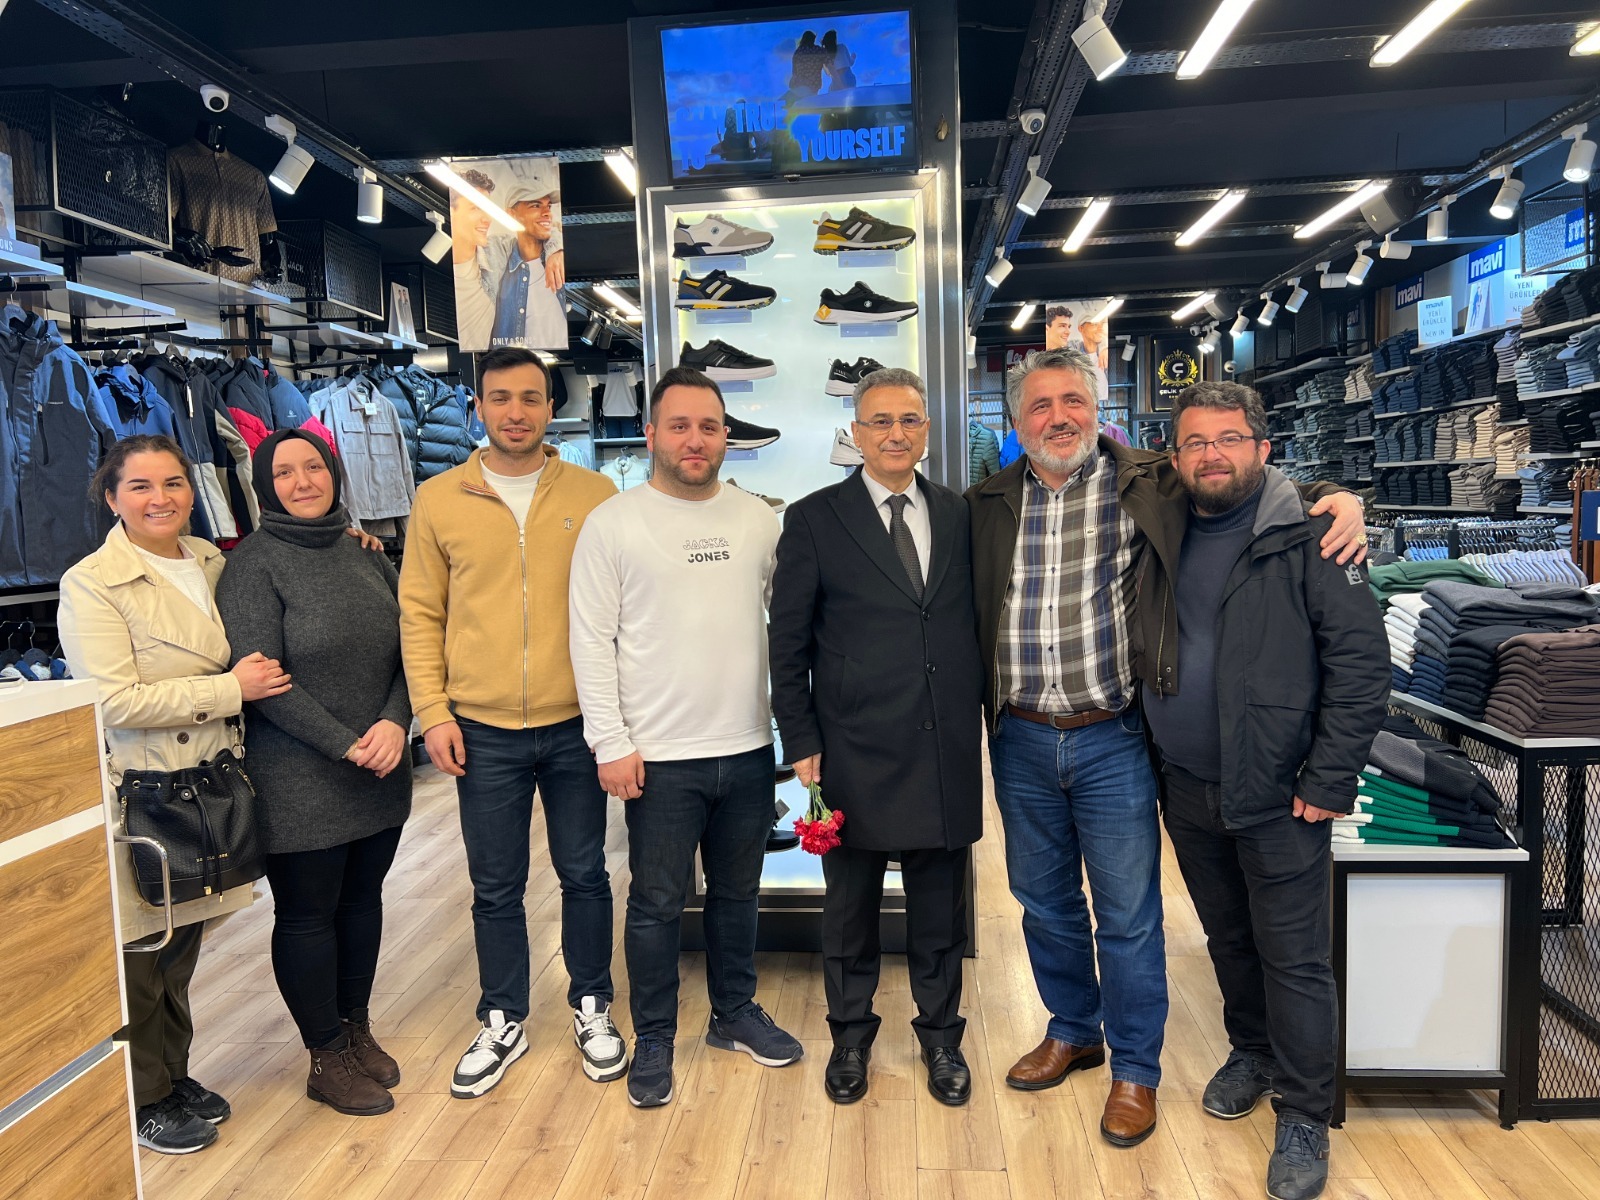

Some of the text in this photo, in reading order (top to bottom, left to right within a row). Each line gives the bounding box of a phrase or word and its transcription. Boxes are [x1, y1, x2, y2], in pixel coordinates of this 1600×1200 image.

[734, 101, 786, 133] TRUE
[800, 126, 905, 163] YOURSELF
[0, 239, 13, 251] ONS
[1471, 244, 1503, 279] mavi
[1397, 278, 1422, 307] mavi
[1347, 304, 1359, 325] avi
[492, 337, 509, 346] ONLY
[688, 550, 730, 563] JONES
